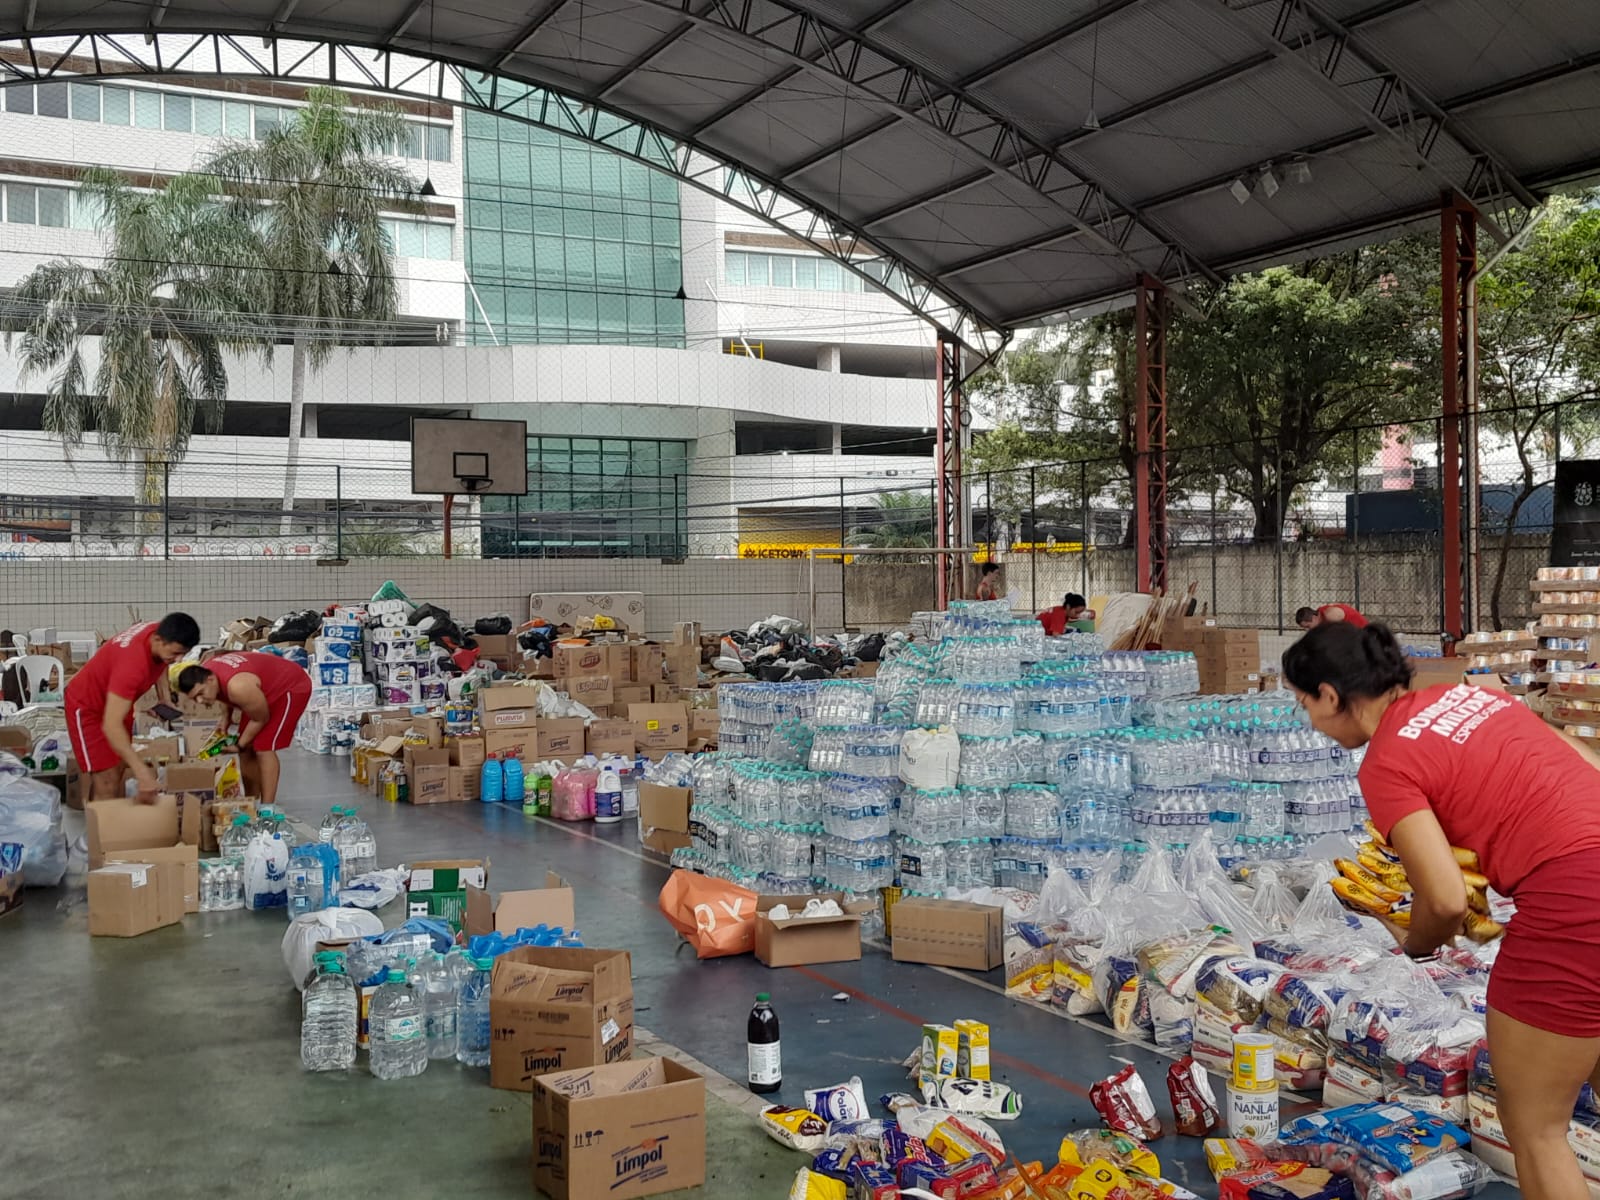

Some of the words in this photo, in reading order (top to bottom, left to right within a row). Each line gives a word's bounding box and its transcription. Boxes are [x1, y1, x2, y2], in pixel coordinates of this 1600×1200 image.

[1430, 690, 1498, 738] MILITAR
[422, 781, 444, 793] Limpol
[554, 985, 585, 997] Limpol
[604, 1030, 630, 1065] Limpol
[524, 1053, 562, 1073] Limpol
[1234, 1101, 1278, 1115] NANLAC
[538, 1136, 562, 1159] Limpol
[616, 1143, 663, 1177] Limpol
